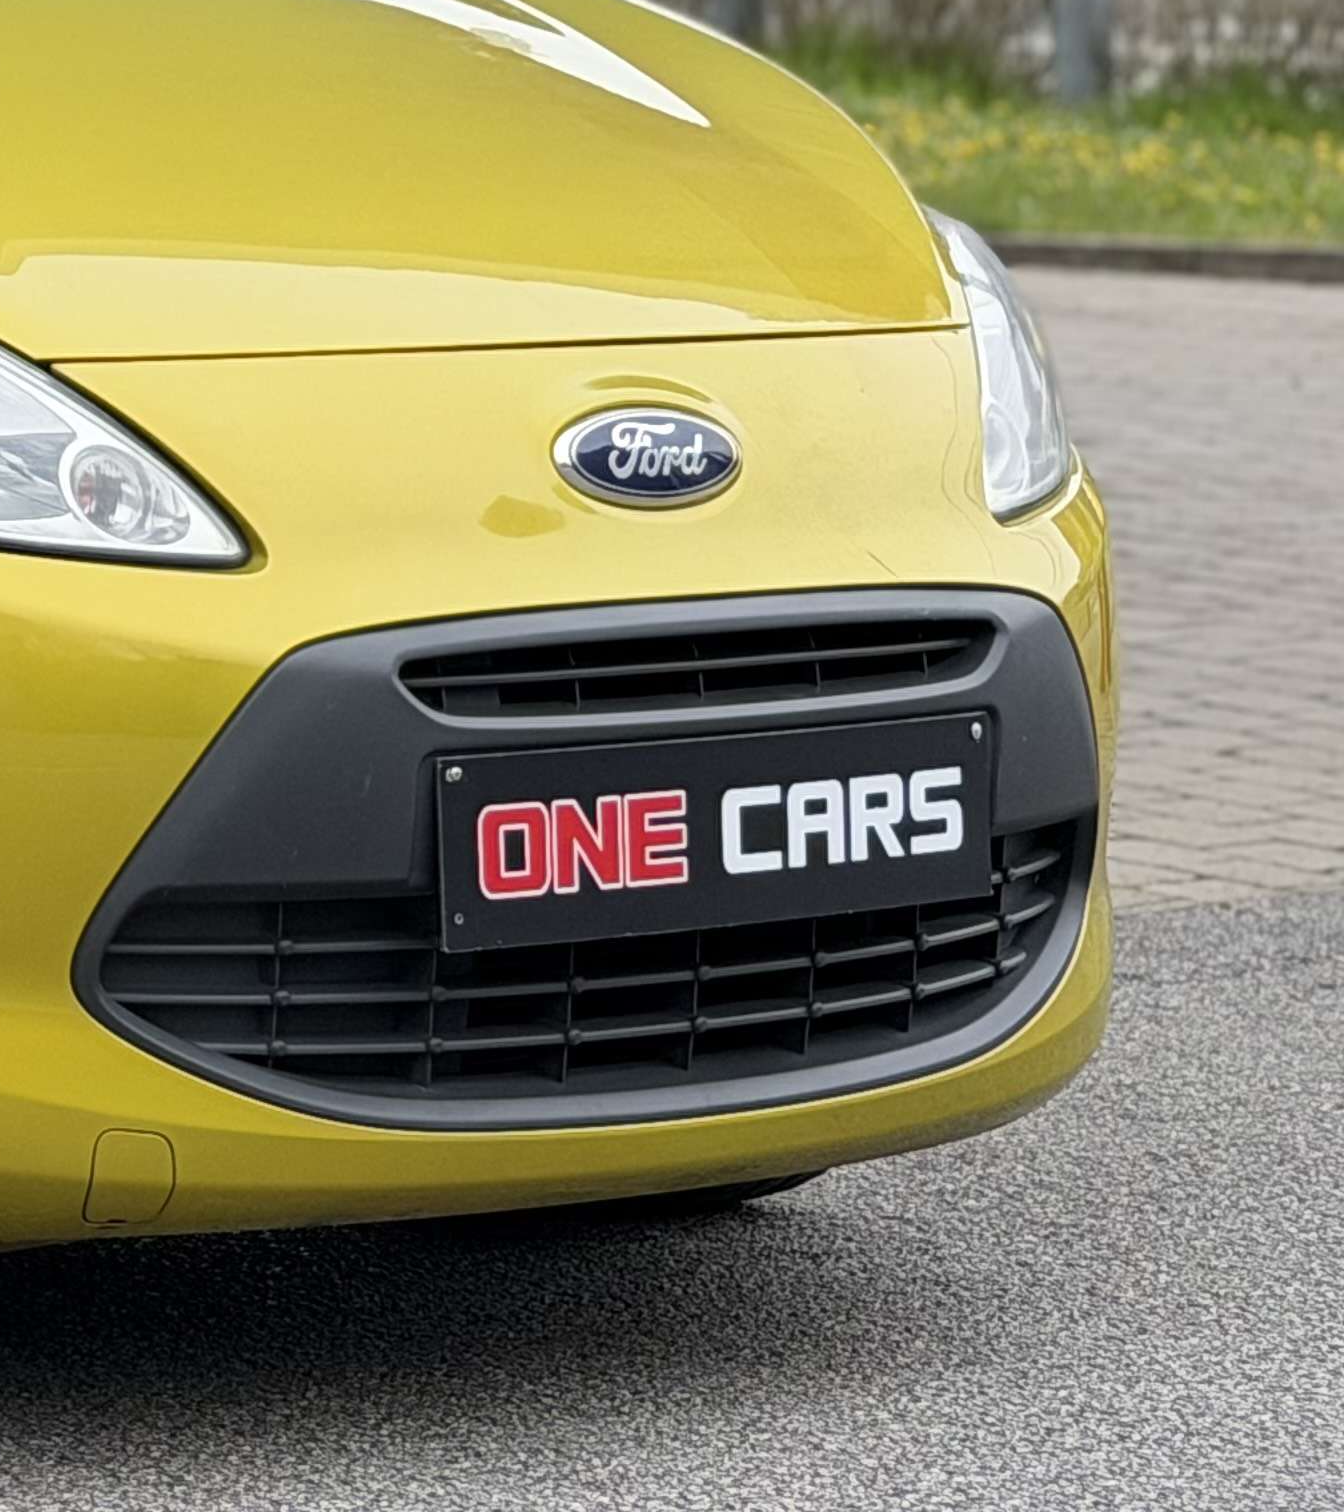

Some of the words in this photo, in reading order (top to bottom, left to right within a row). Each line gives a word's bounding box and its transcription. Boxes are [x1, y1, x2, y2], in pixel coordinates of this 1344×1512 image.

[608, 421, 707, 479] Ford
[477, 789, 689, 900] ONE
[721, 766, 964, 875] CARS
